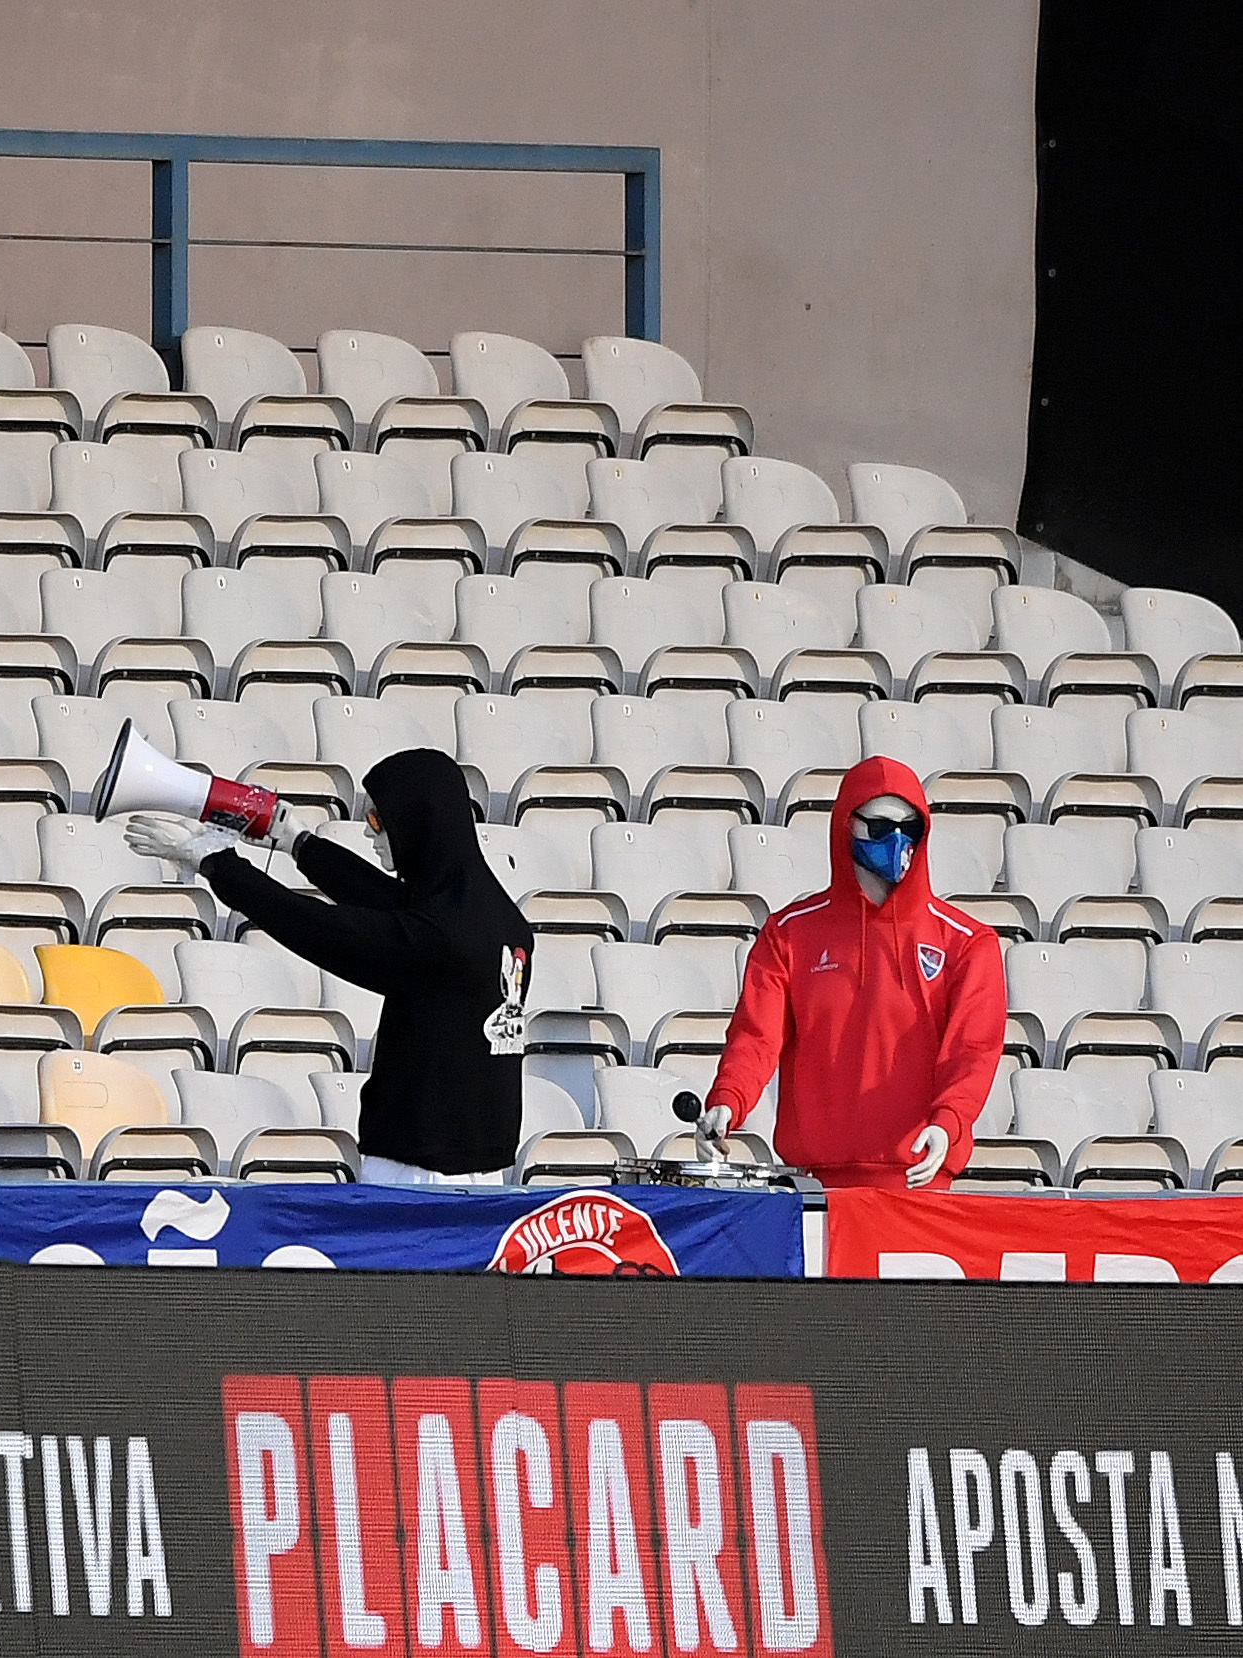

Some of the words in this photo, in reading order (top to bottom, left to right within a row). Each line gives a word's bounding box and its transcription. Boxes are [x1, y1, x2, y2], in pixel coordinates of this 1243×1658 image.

[514, 1203, 624, 1263] VICENTE
[235, 1411, 820, 1654] PLACARD
[907, 1447, 1193, 1627] APOSTA
